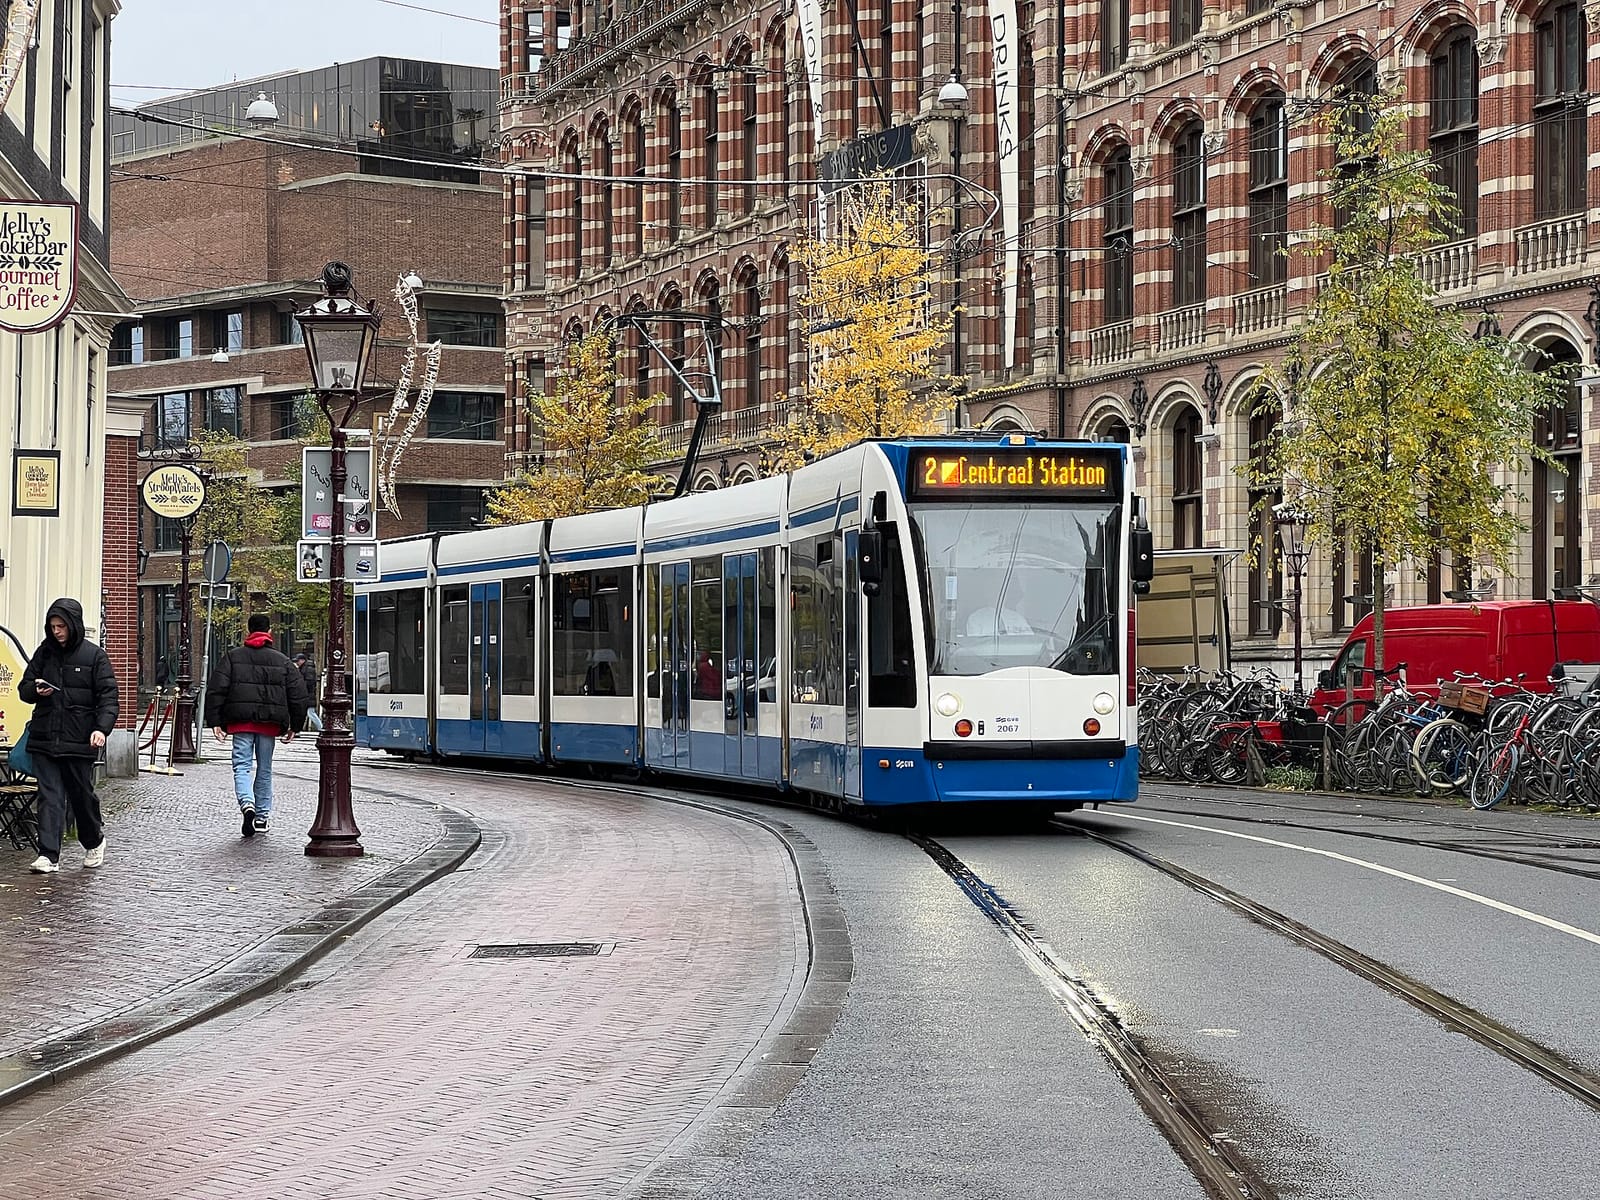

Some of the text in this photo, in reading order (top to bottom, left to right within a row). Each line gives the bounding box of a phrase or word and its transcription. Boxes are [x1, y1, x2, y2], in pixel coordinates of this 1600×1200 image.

[803, 0, 818, 83] HION
[993, 14, 1013, 160] DRINKS
[829, 136, 888, 176] SHOPPING
[161, 473, 188, 487] Melly's
[925, 456, 1106, 485] 2 Centraal Station
[997, 724, 1019, 733] 2067
